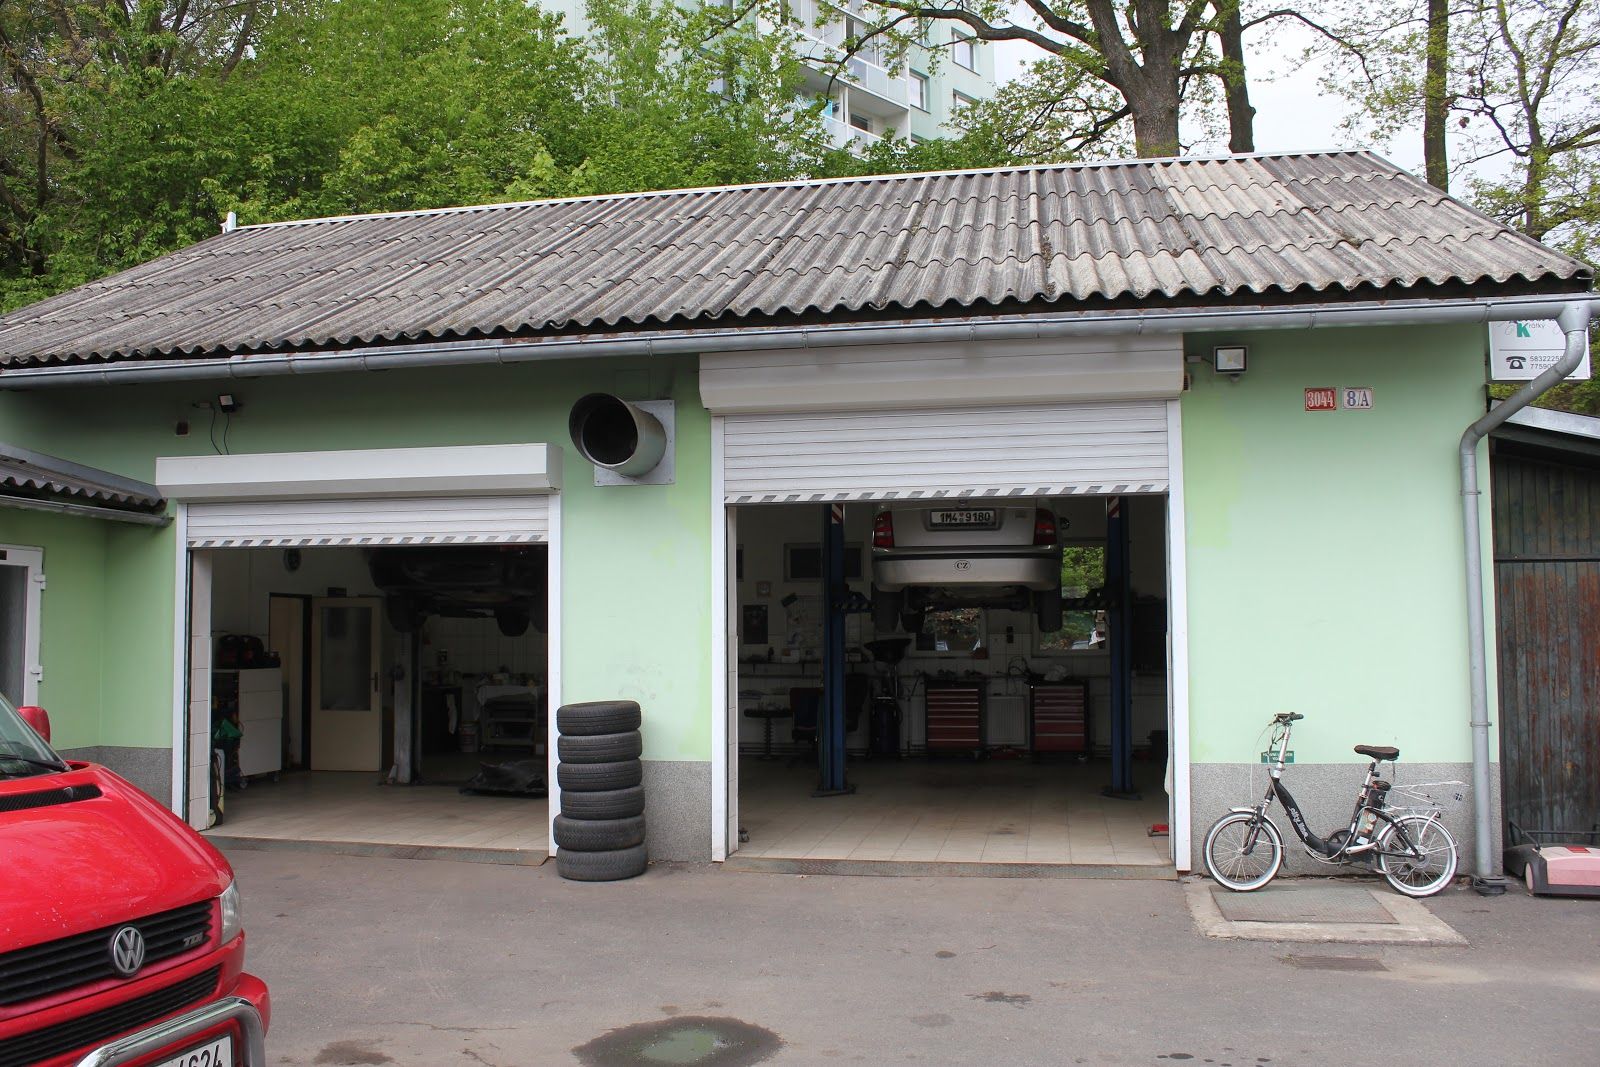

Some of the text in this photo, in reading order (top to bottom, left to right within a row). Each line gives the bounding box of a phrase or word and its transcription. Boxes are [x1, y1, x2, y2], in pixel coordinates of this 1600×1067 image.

[1307, 391, 1334, 408] 3044
[956, 561, 968, 570] CZ
[183, 932, 204, 947] TDI
